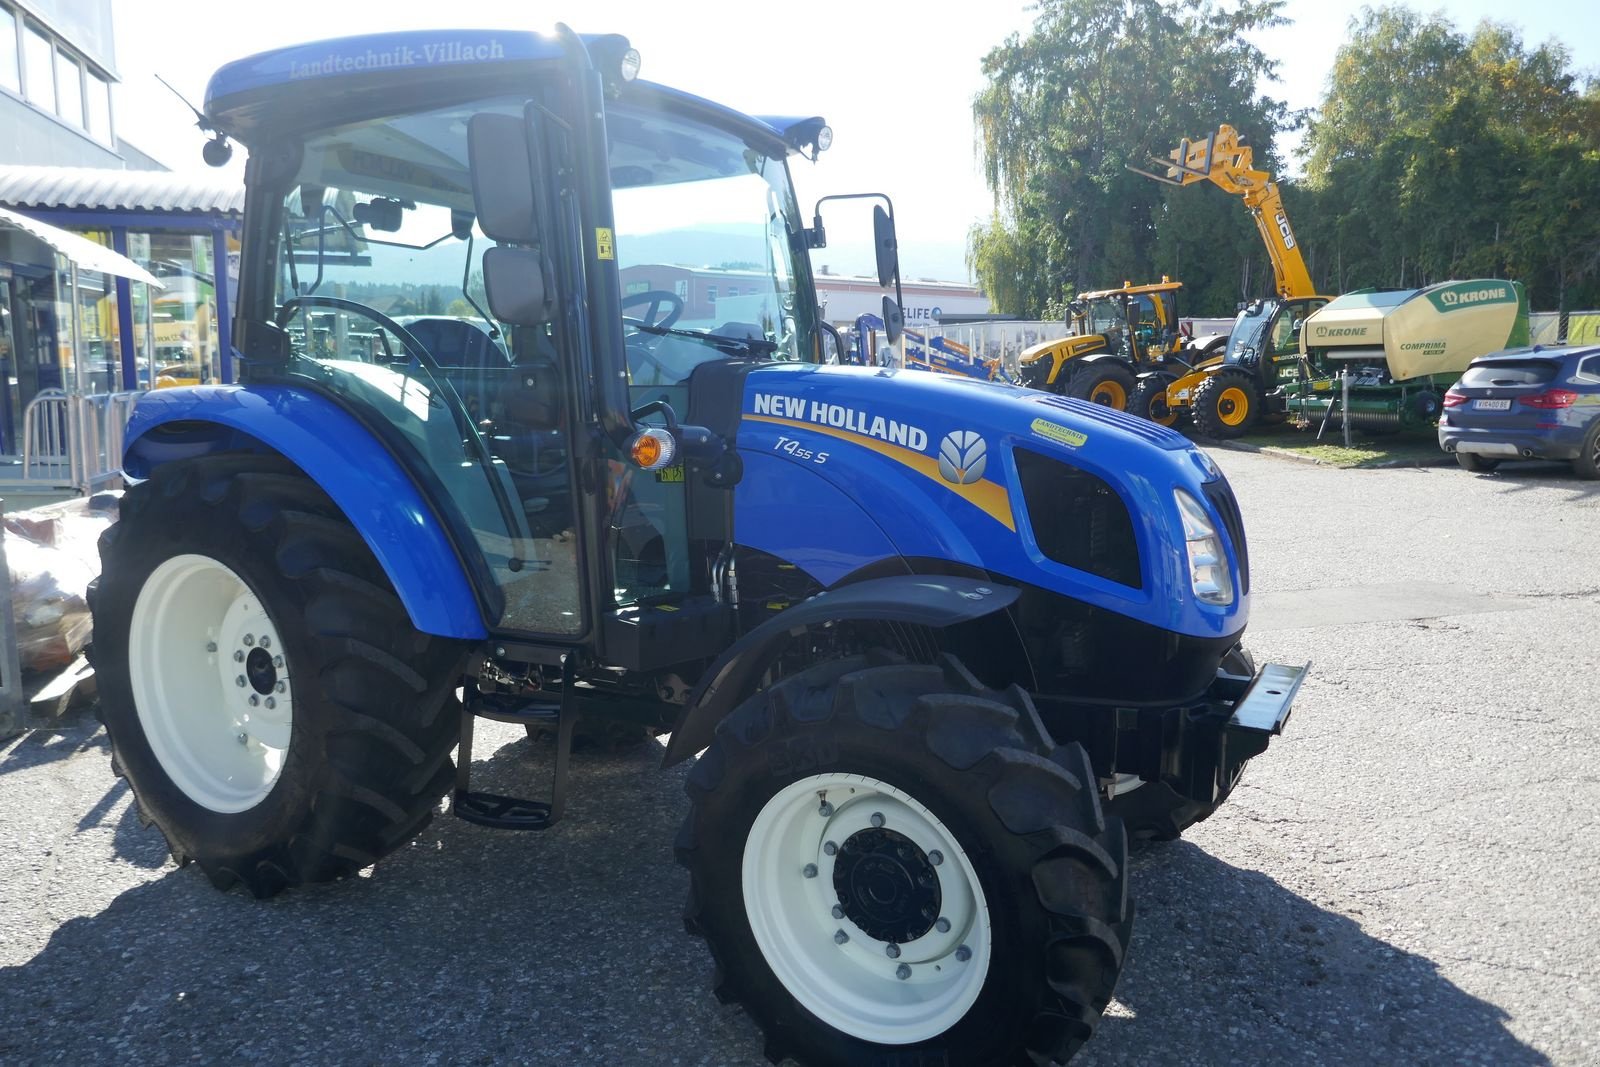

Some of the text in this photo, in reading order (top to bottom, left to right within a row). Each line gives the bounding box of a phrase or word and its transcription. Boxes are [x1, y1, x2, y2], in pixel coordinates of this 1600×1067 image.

[289, 39, 505, 79] Landtechnik-Villach
[1275, 212, 1294, 249] JCB
[1459, 288, 1506, 303] KRONE
[1328, 327, 1367, 337] KRONE
[1400, 342, 1447, 350] COMPRIMA
[754, 393, 928, 451] NEW HOLLAND
[1036, 419, 1084, 440] LANDTECHNIK
